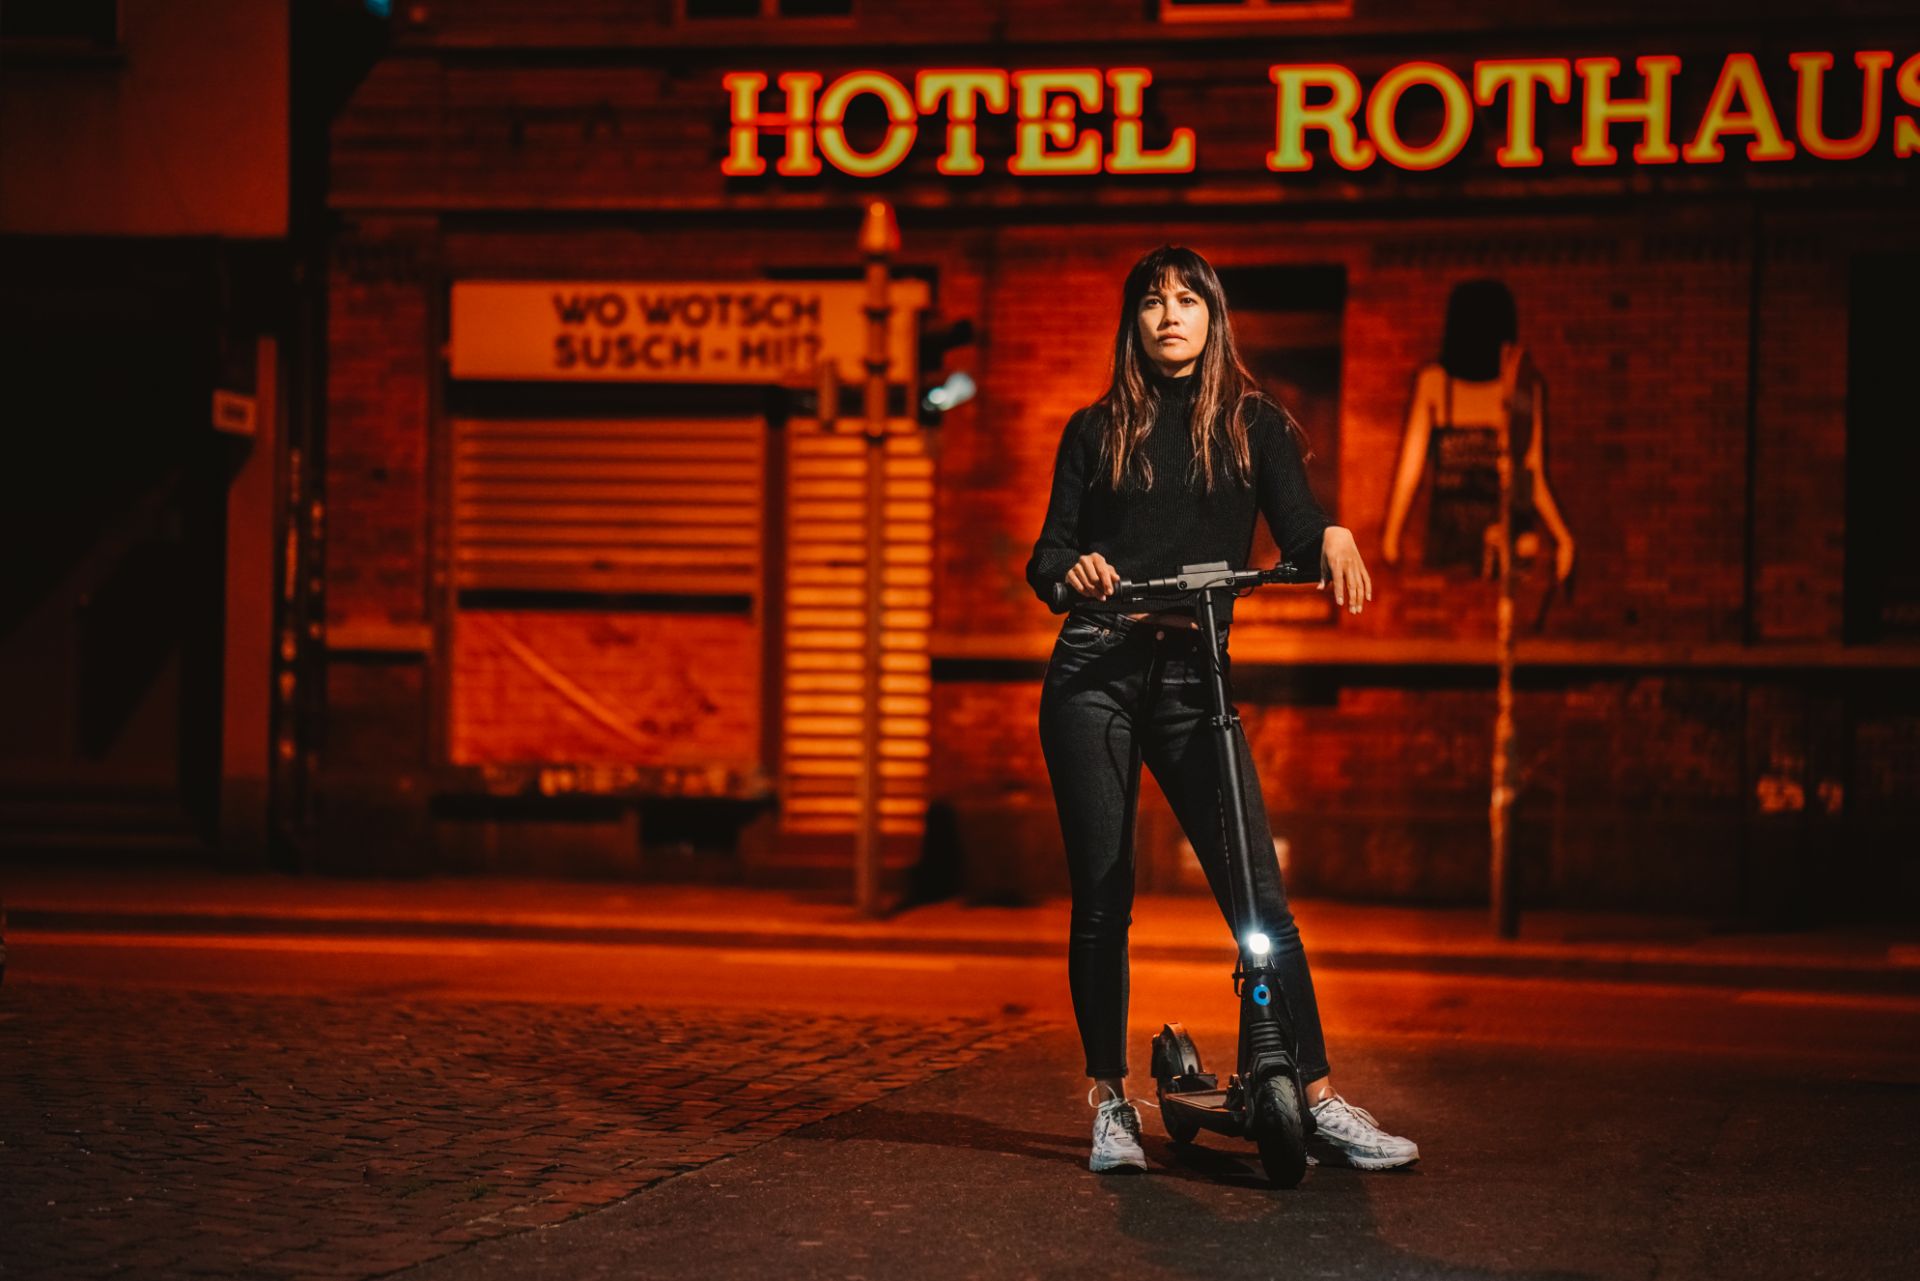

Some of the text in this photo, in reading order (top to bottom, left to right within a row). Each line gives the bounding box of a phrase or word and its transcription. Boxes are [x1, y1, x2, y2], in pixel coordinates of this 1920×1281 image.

[721, 67, 1196, 177] HOTEL
[552, 292, 822, 328] WO WOTSCH
[554, 334, 701, 369] SUSCH
